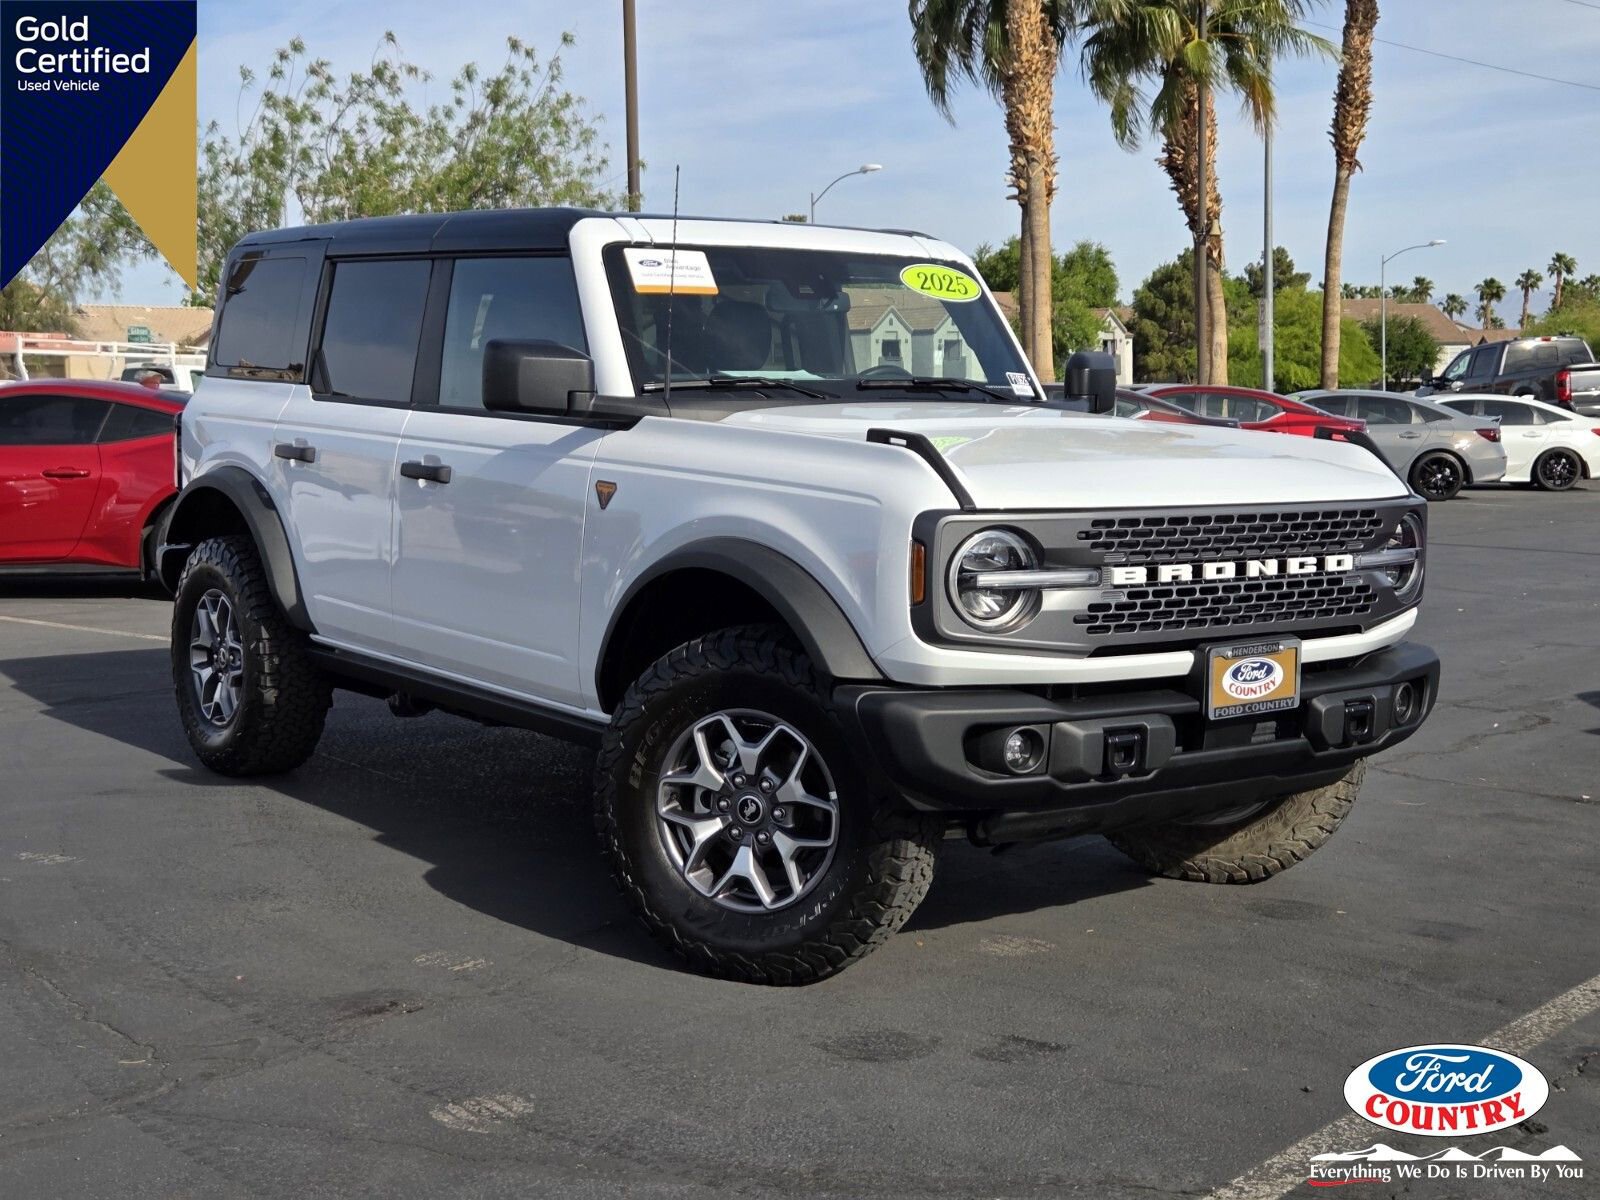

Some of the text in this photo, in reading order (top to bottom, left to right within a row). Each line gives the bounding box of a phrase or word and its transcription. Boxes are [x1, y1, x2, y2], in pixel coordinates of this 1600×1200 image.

[641, 259, 660, 267] Ford
[916, 271, 969, 295] 2025
[1110, 554, 1354, 586] BRONCO
[1232, 643, 1280, 656] HENDERSON
[1237, 662, 1268, 681] Ford
[1229, 677, 1277, 697] COUNTRY
[1215, 698, 1295, 718] FORD COUNTRY
